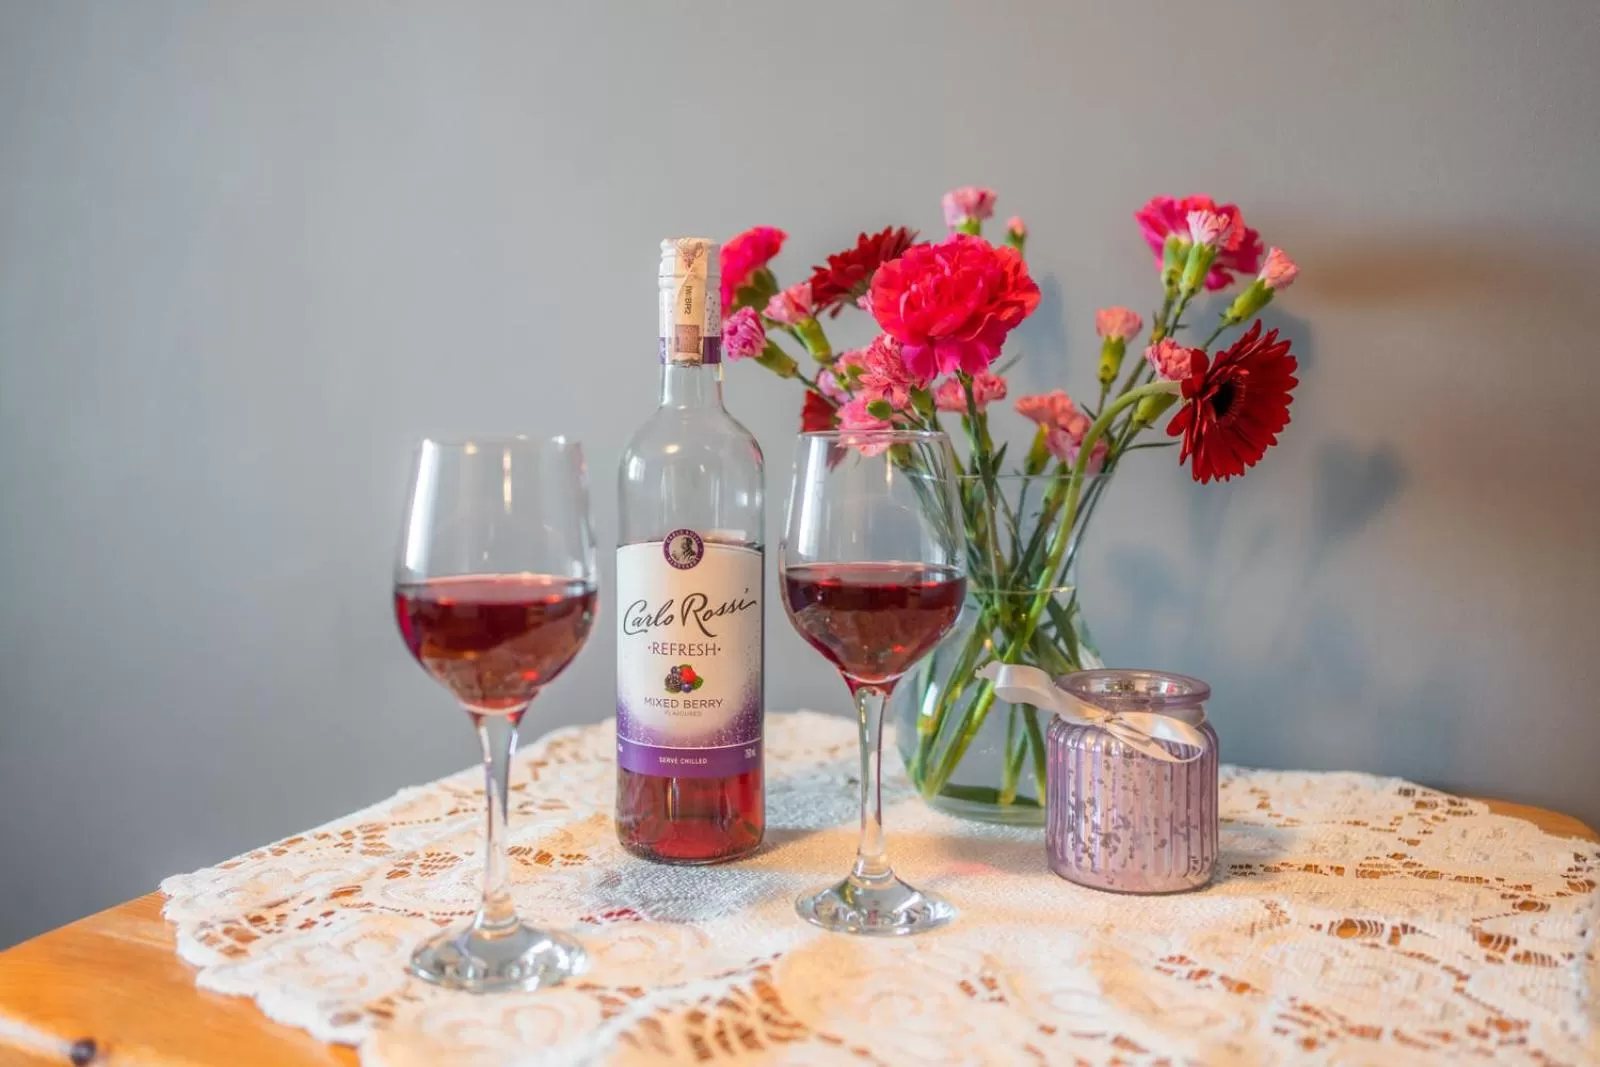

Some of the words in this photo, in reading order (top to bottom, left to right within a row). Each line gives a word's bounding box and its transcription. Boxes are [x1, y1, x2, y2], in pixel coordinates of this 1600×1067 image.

[623, 599, 675, 635] Carlo
[681, 588, 757, 637] Rossi
[643, 696, 680, 709] MIXED
[683, 698, 724, 709] BERRY
[658, 756, 679, 765] SERVE
[680, 757, 708, 765] CHILLED
